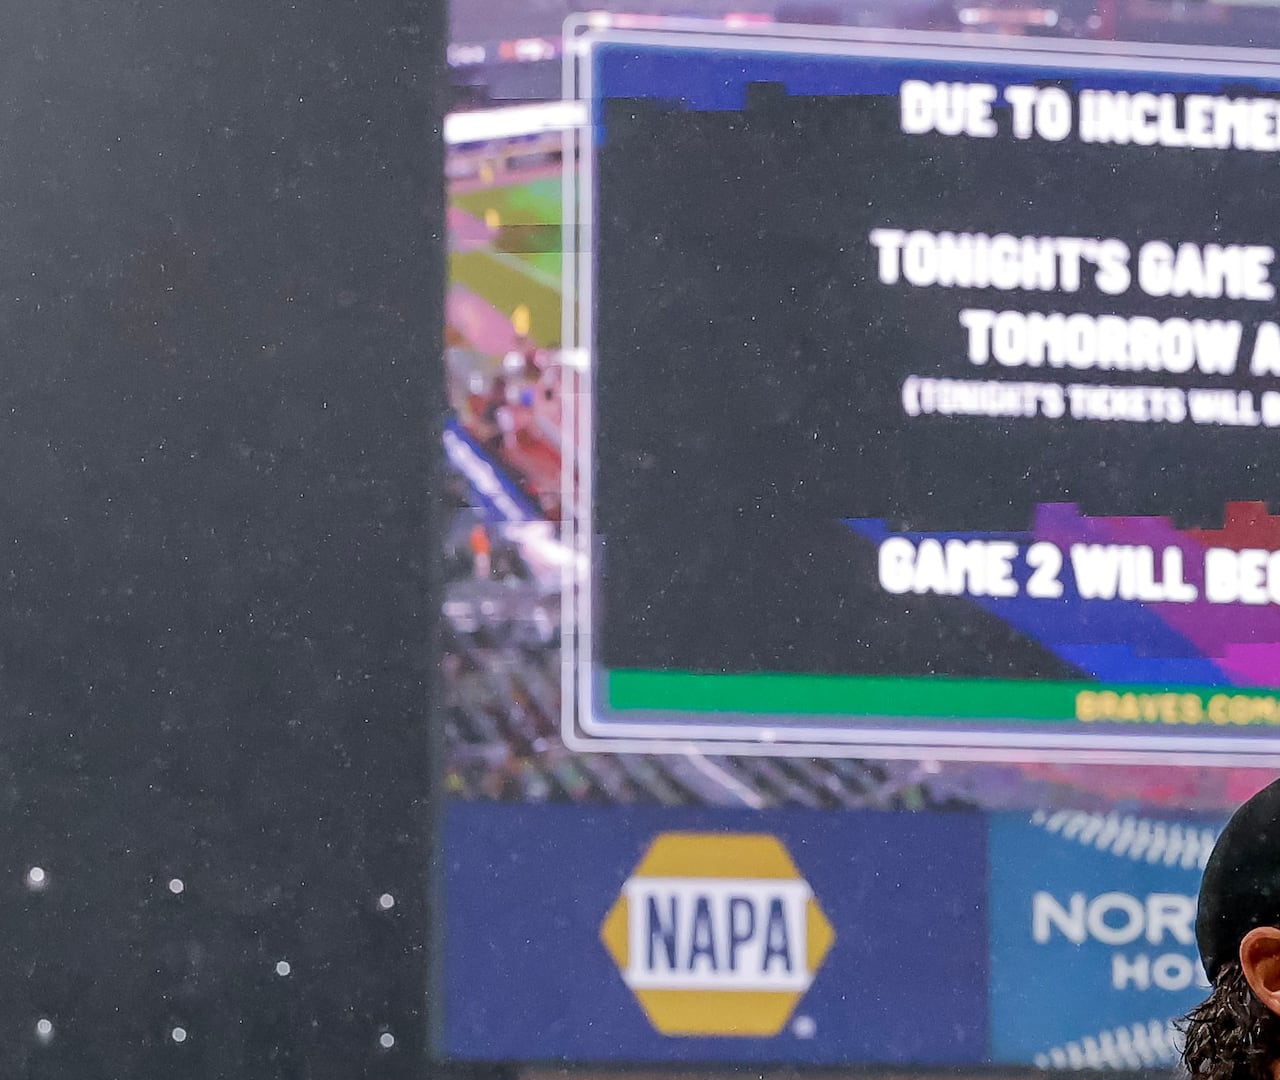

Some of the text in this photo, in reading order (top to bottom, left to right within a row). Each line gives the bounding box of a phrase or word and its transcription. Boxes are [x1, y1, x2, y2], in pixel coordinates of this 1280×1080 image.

[900, 80, 998, 138] DUE
[1003, 85, 1072, 141] TO
[869, 228, 1131, 295] TONIGHT'S
[1138, 241, 1275, 301] GAME
[958, 308, 1242, 376] TOMORROW
[1188, 387, 1261, 426] WILL
[878, 537, 1019, 597] GAME
[1025, 541, 1064, 599] 2
[1070, 543, 1199, 601] WILL
[648, 893, 795, 972] NAPA
[1032, 891, 1198, 945] NOR
